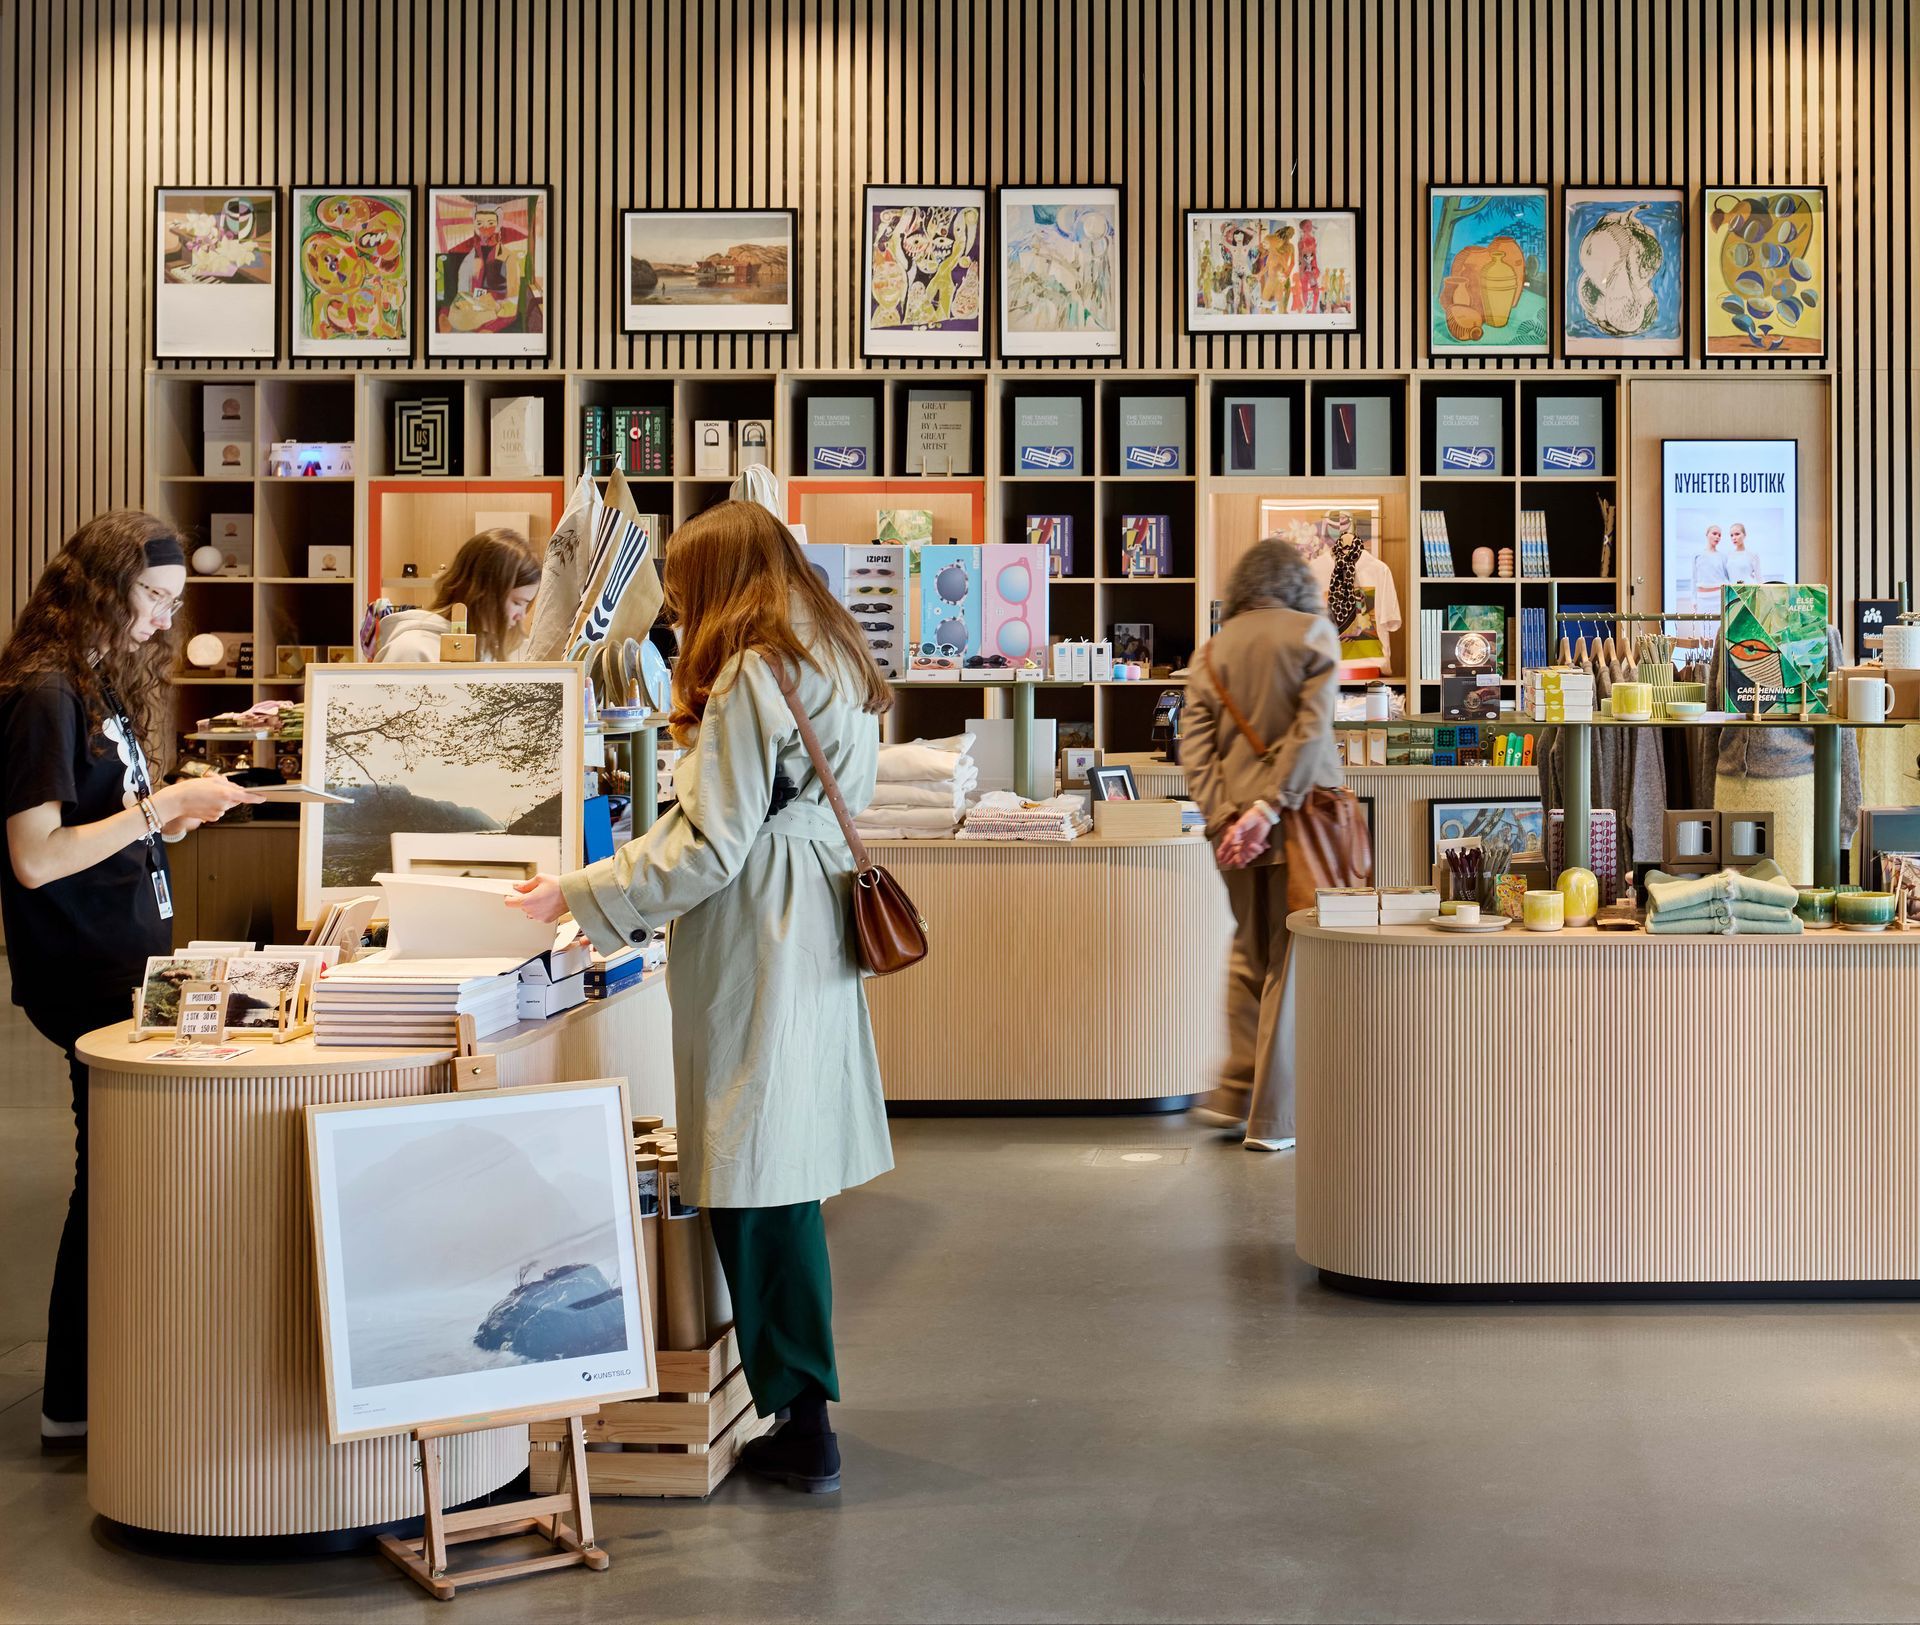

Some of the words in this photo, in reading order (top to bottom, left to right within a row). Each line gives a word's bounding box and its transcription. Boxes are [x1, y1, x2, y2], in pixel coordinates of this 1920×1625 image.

[416, 430, 428, 445] US
[1675, 473, 1729, 493] NYHETER
[1734, 473, 1737, 493] I
[1741, 473, 1785, 493] BUTIKK
[593, 1369, 631, 1379] KUNSTSILO
